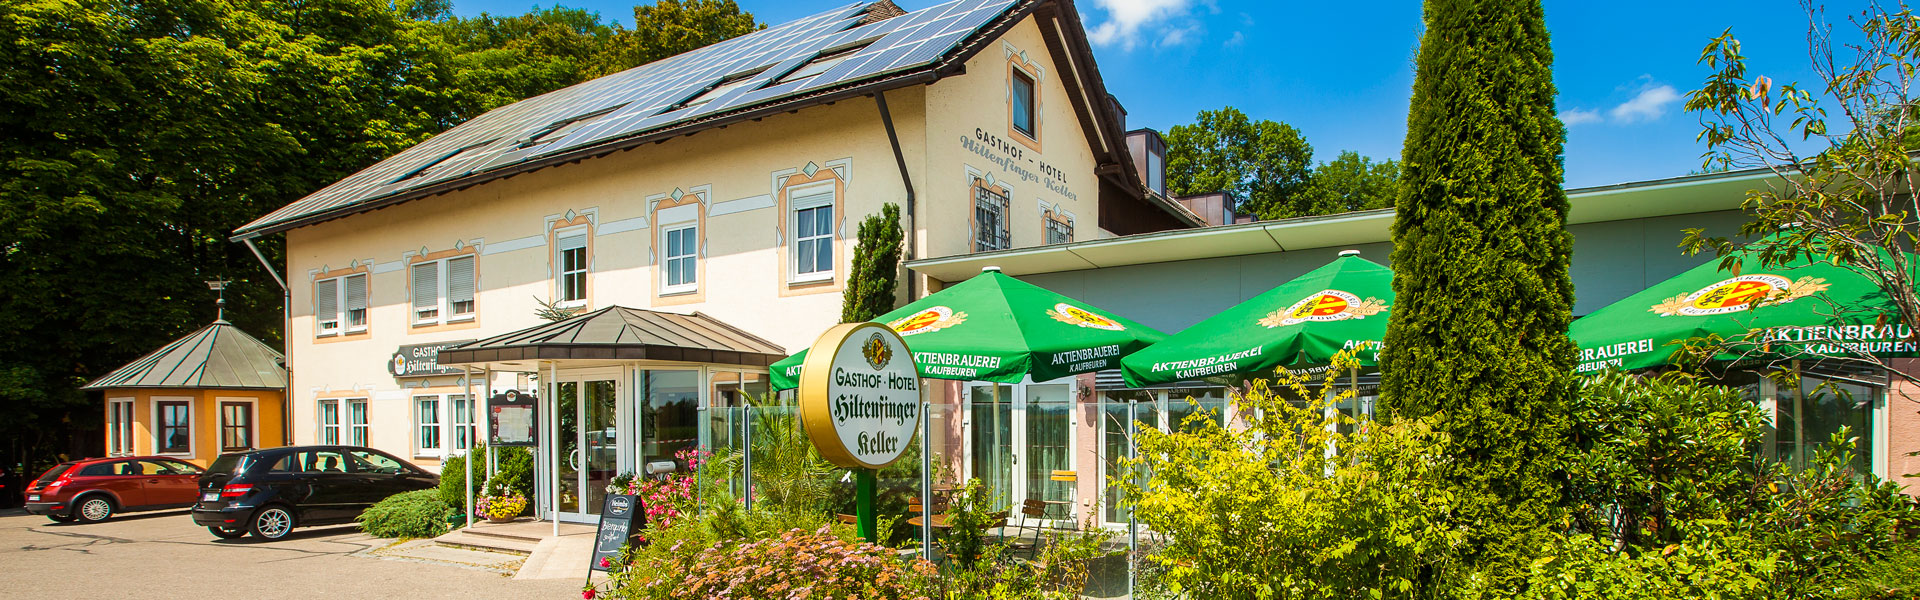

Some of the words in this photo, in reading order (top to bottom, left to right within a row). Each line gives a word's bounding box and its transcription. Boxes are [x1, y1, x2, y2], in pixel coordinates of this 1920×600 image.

[975, 127, 1023, 160] GASTHOF
[1039, 160, 1067, 183] HOTEL
[960, 135, 1039, 183] Hiltenfinger
[1043, 176, 1078, 202] Keller
[912, 351, 1001, 369] KTIENBRAUEREI
[1051, 344, 1120, 366] AKTIENBRAUEREI
[1069, 358, 1107, 373] KAUFBEUREN
[1151, 345, 1263, 373] AKTIENBRAUEREI
[835, 366, 882, 389] GASTHOF
[888, 371, 917, 391] HOTEL
[925, 365, 977, 378] KAUFBEUREN
[1175, 361, 1238, 379] KAUFBEUREN
[834, 393, 917, 427] Hiltenfinger
[857, 430, 899, 457] Keller
